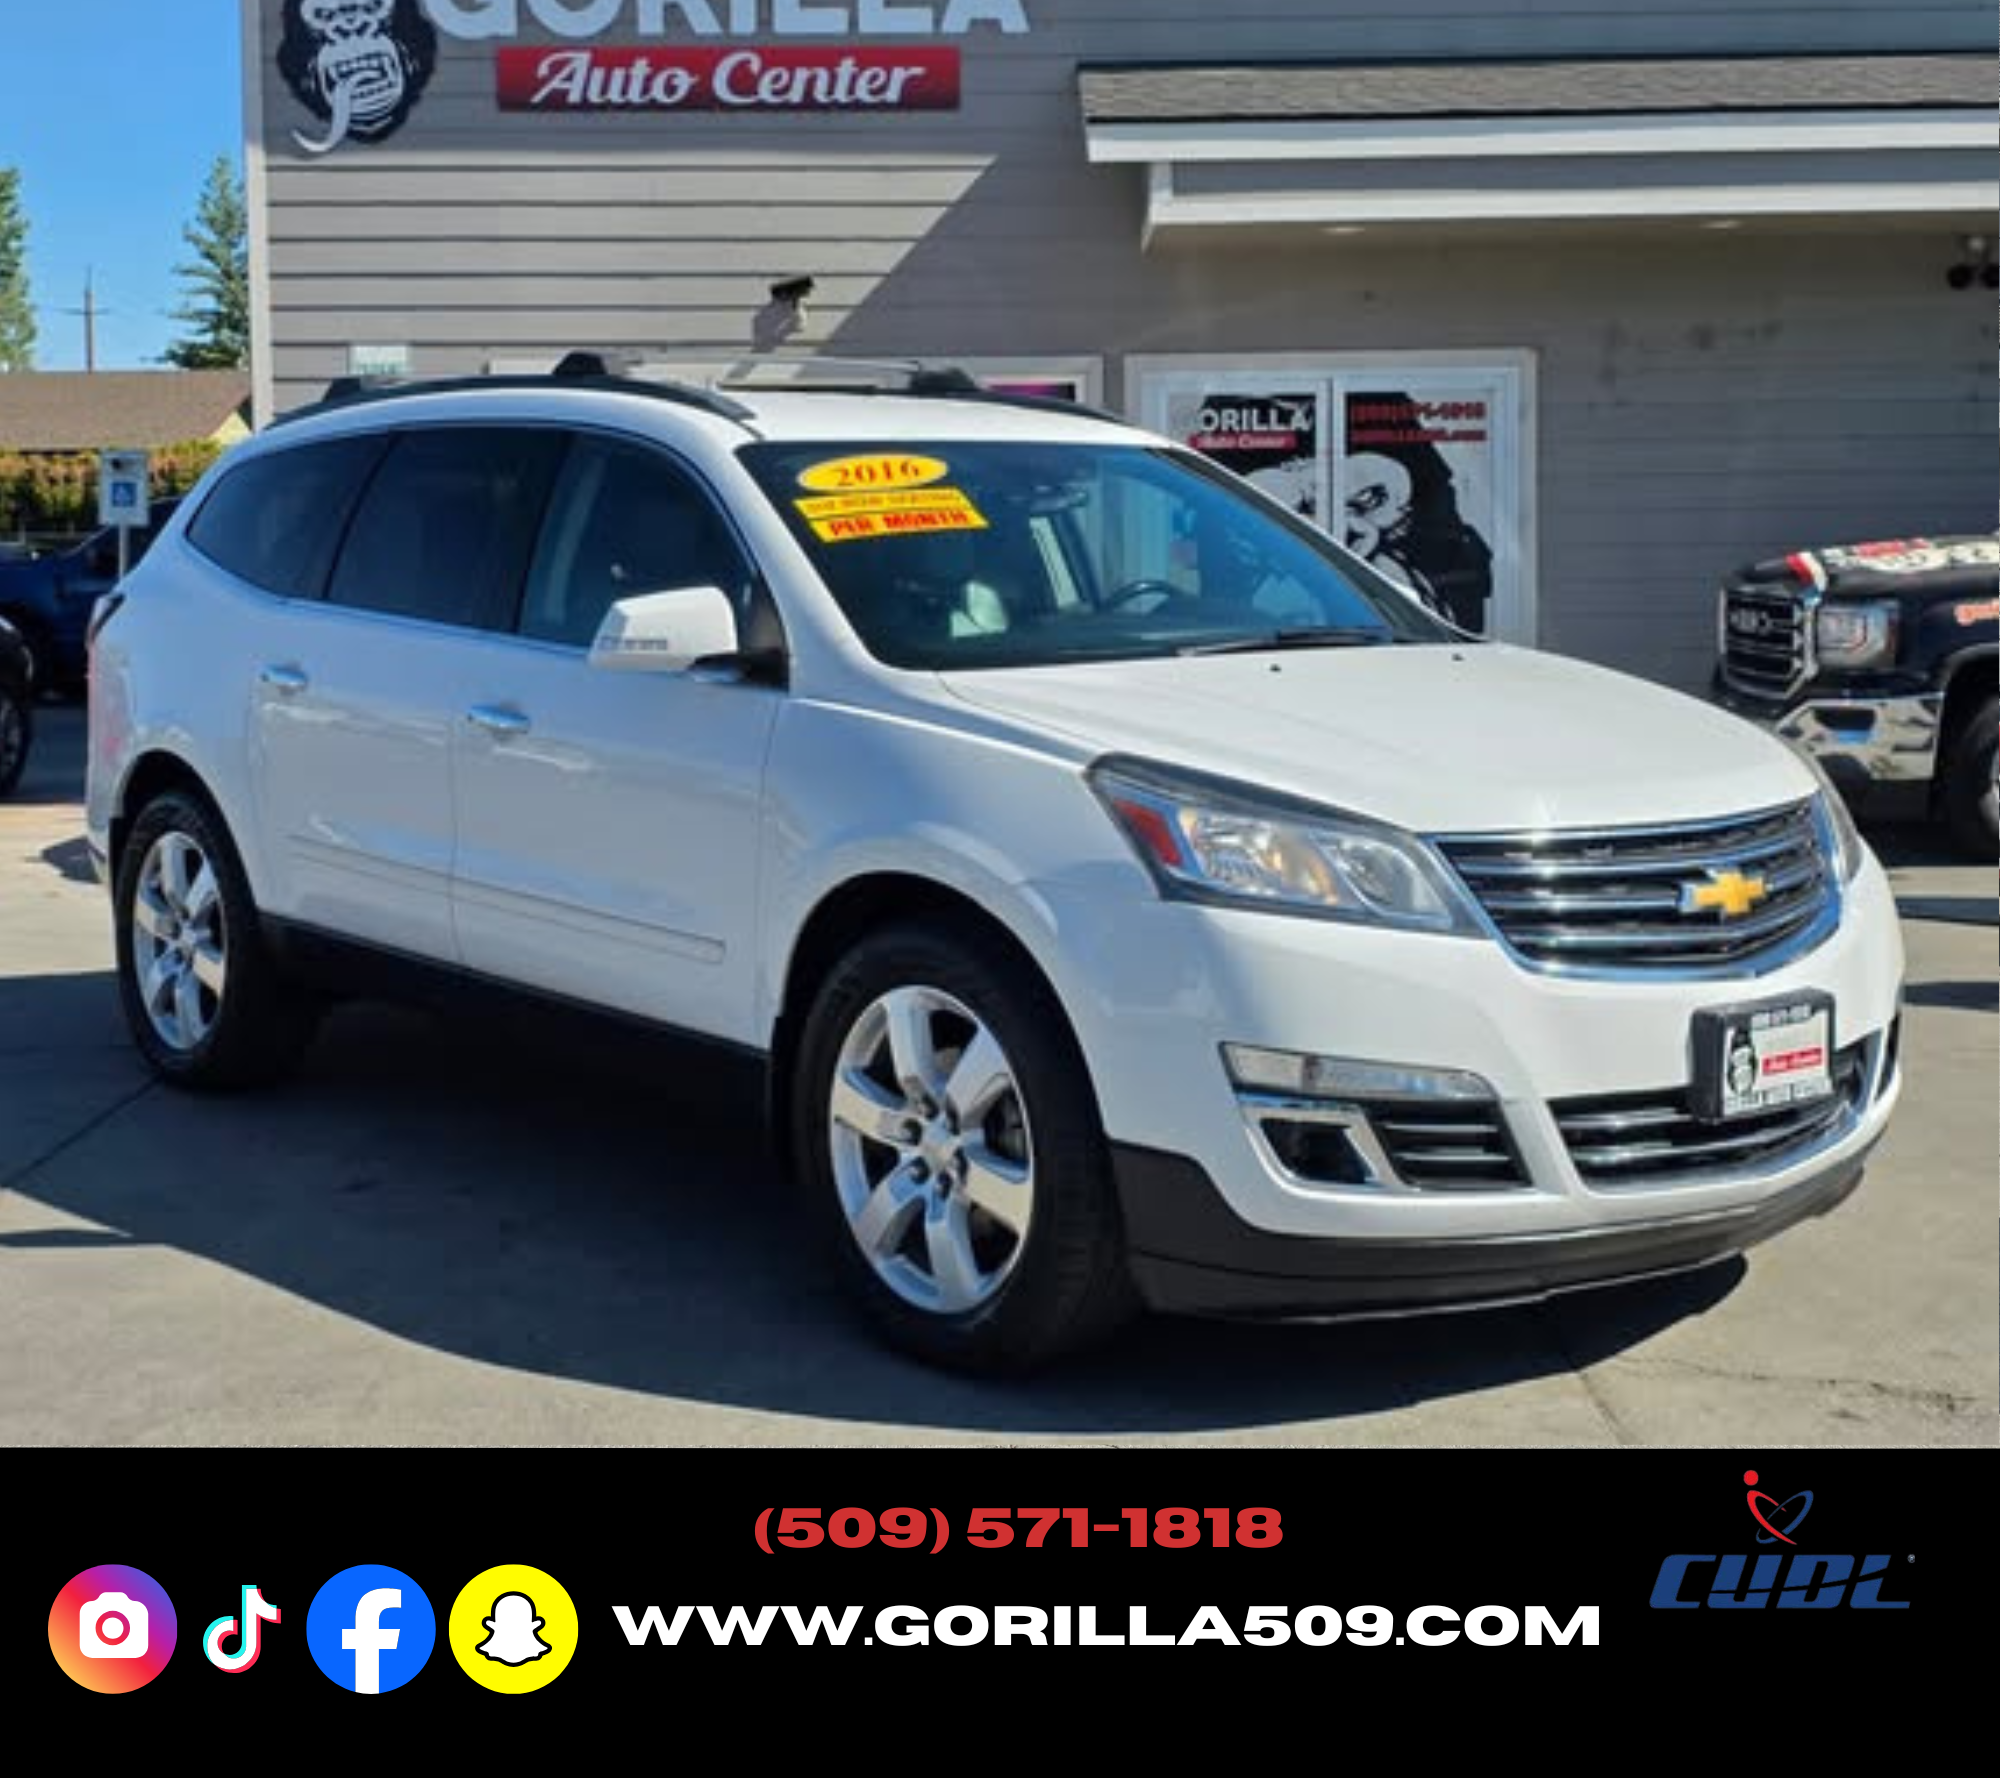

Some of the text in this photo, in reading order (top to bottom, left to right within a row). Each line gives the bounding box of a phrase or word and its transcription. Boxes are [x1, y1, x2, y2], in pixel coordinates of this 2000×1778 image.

[531, 51, 926, 105] Auto Center
[837, 460, 920, 488] 2016
[829, 507, 969, 537] PER MONTH
